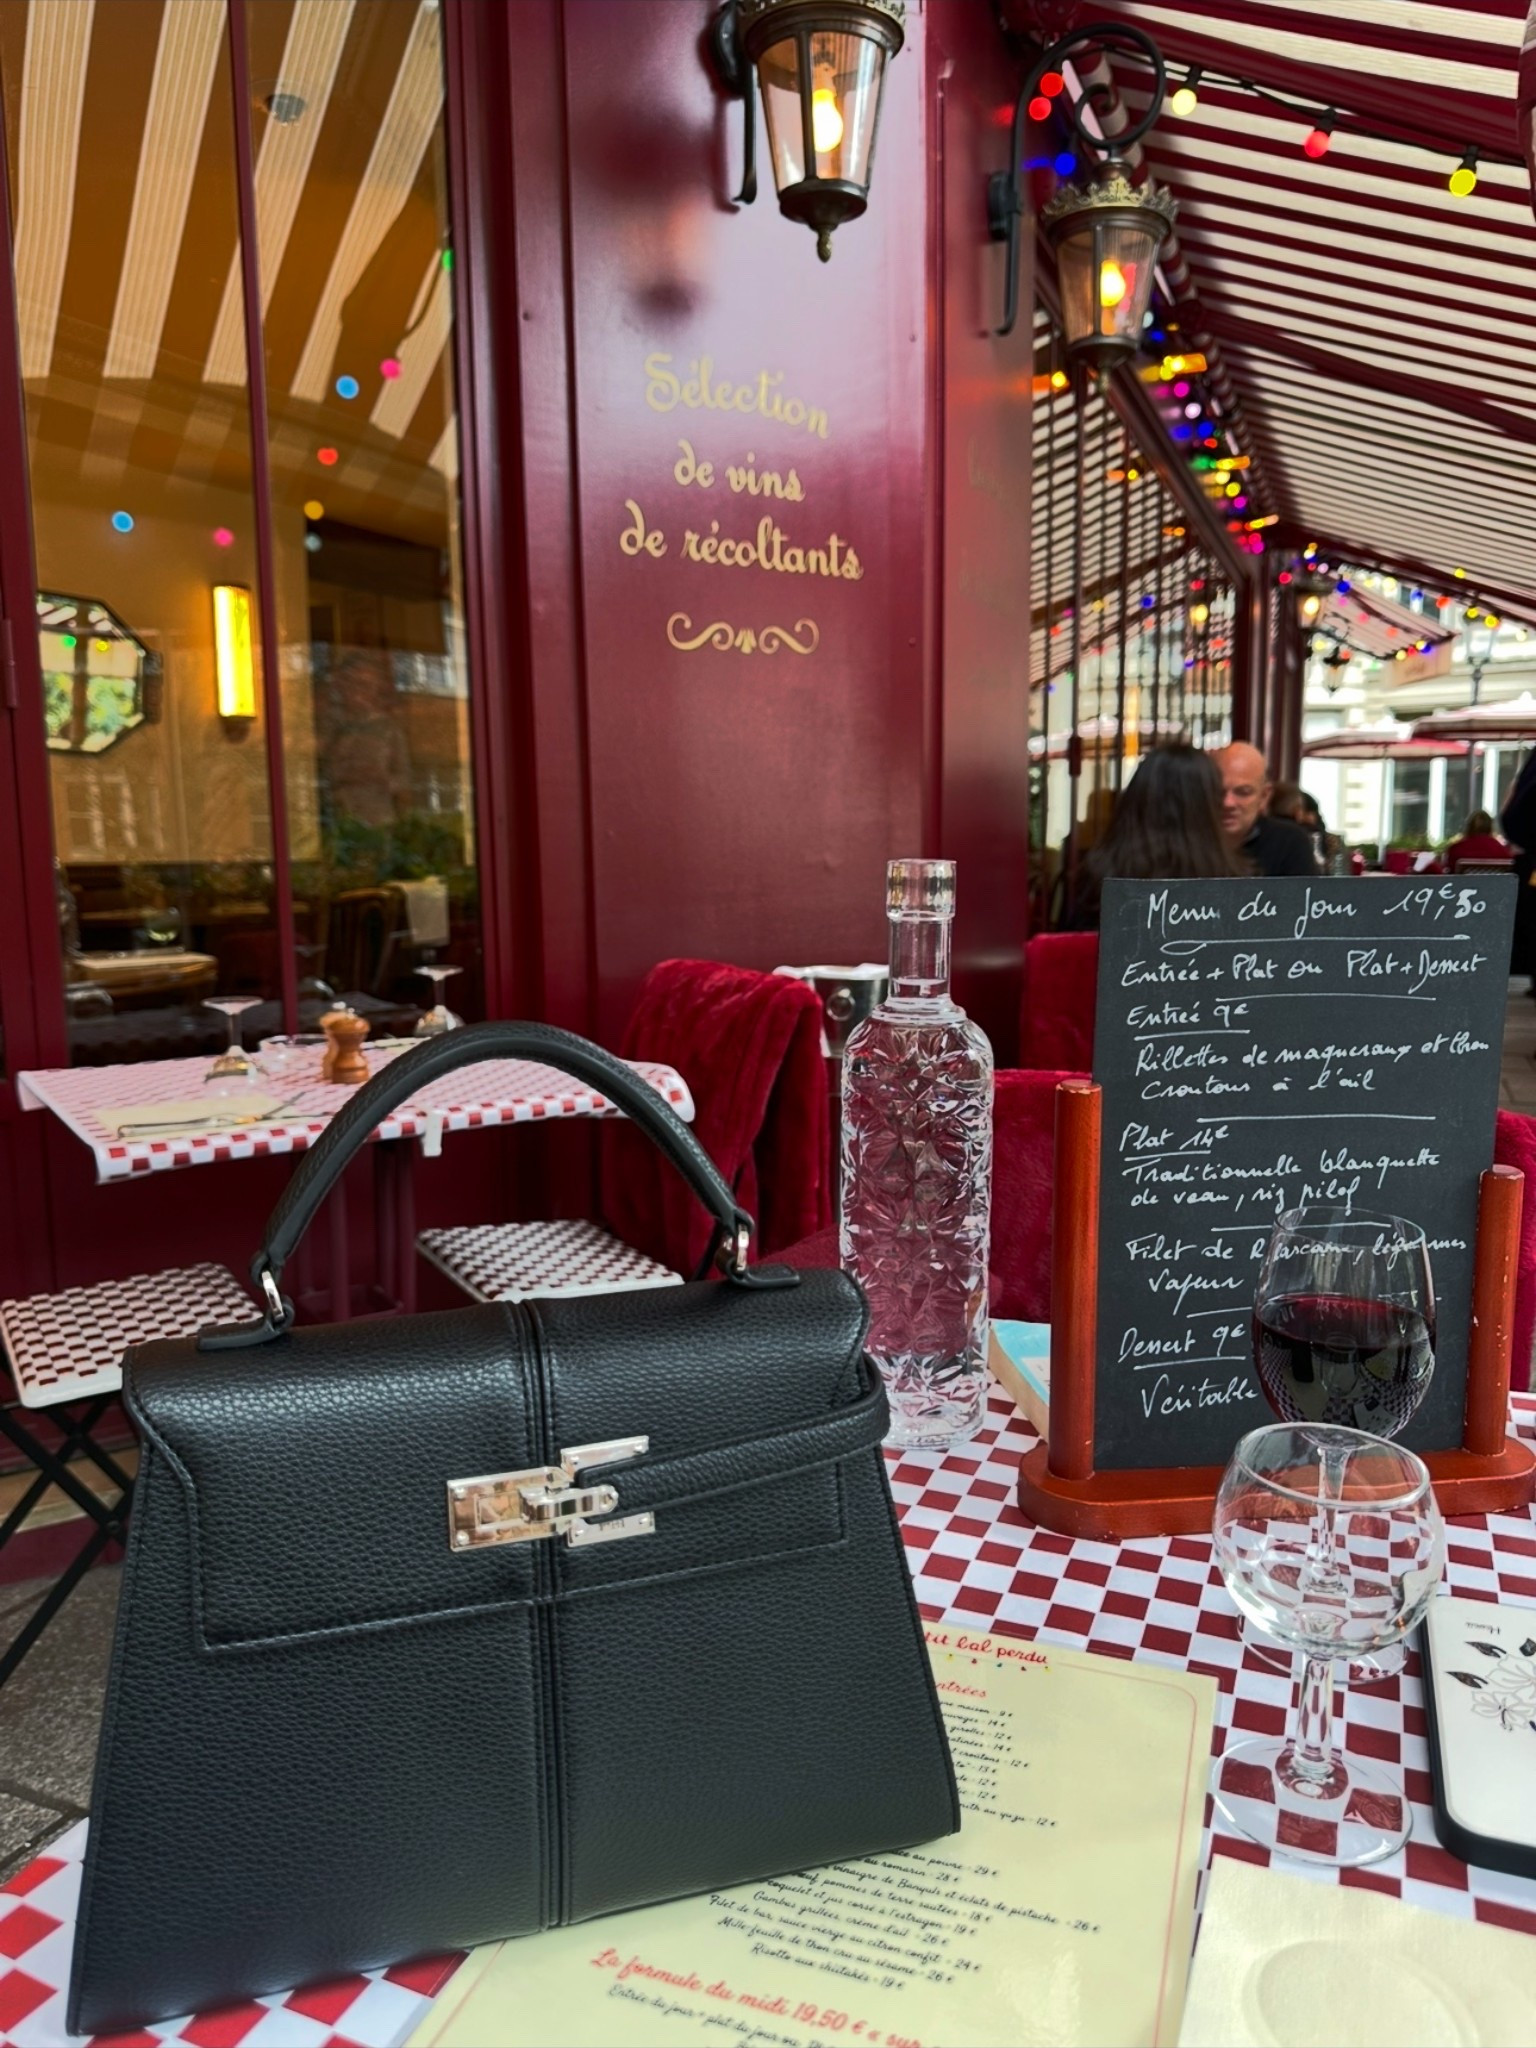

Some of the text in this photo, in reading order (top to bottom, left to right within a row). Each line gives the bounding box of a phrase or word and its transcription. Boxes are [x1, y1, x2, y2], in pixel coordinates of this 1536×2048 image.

[645, 352, 829, 439] Sélection
[674, 438, 805, 501] de vins
[620, 498, 863, 580] de récoltants
[1147, 889, 1220, 939] Menu
[1238, 891, 1277, 921] du
[1121, 958, 1200, 987] Entrée
[1232, 953, 1278, 981] Plat
[1347, 949, 1398, 979] Plat
[1408, 949, 1487, 995] Dessert
[1126, 1001, 1201, 1028] Entrée
[1135, 1042, 1229, 1076] Rillettes
[1242, 1044, 1268, 1067] de
[1421, 1033, 1449, 1053] et
[1450, 1031, 1489, 1054] thon
[1272, 1077, 1293, 1091] à
[1119, 1122, 1174, 1151] Plat
[1122, 1154, 1302, 1184] Traditionnelle
[1131, 1188, 1159, 1207] de
[1125, 1232, 1197, 1261] Filet
[1201, 1238, 1234, 1259] de
[1118, 1327, 1196, 1363] Dessert
[1141, 1373, 1259, 1418] Véritable
[956, 1635, 992, 1653] bal
[996, 1646, 1049, 1664] perdu
[935, 1680, 987, 1699] ntrées
[709, 1894, 736, 1910] Filet
[736, 1903, 749, 1913] de
[753, 1889, 797, 1909] Gambas
[813, 1891, 826, 1899] et
[870, 1888, 883, 1898] de
[881, 1875, 893, 1885] de
[944, 1890, 957, 1899] et
[993, 1901, 1007, 1911] de
[750, 1942, 792, 1961] Risotto
[787, 1935, 802, 1945] de
[591, 1947, 621, 1968] La
[616, 1954, 703, 1991] formule
[705, 1980, 735, 2000] du
[737, 1993, 790, 2016] midi
[792, 2001, 849, 2032] 19,50
